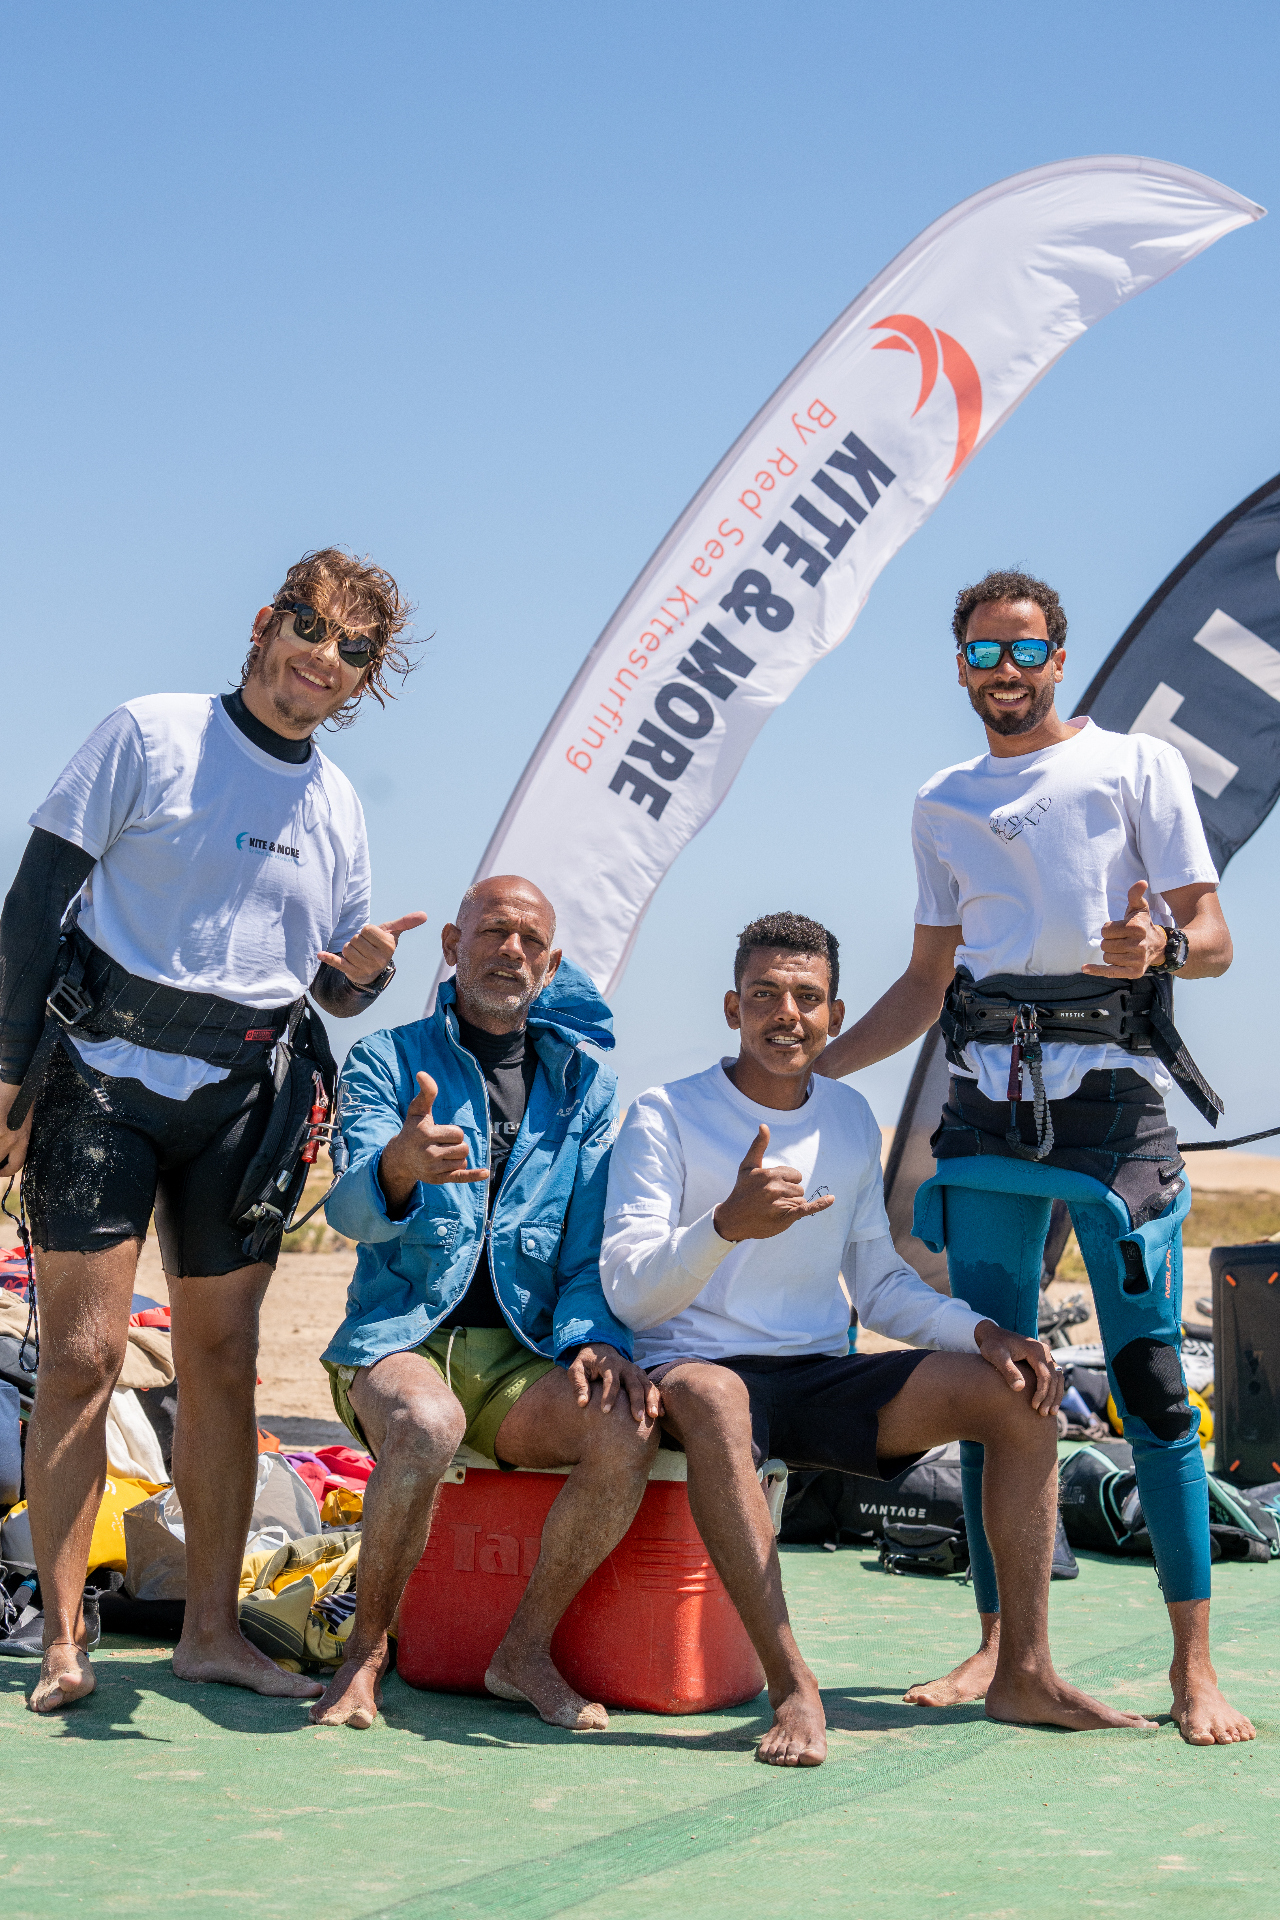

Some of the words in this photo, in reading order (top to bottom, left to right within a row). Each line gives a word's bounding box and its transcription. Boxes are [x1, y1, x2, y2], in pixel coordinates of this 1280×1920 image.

[791, 398, 837, 445] By
[738, 447, 799, 519] Red
[762, 431, 897, 588] KITE
[690, 518, 744, 578] Sea
[718, 568, 795, 633] &
[565, 585, 699, 773] Kitesurfing
[608, 622, 757, 821] MORE
[249, 837, 268, 850] KITE
[268, 841, 276, 853] &
[276, 843, 300, 859] MORE
[859, 1502, 927, 1519] VANTAGE
